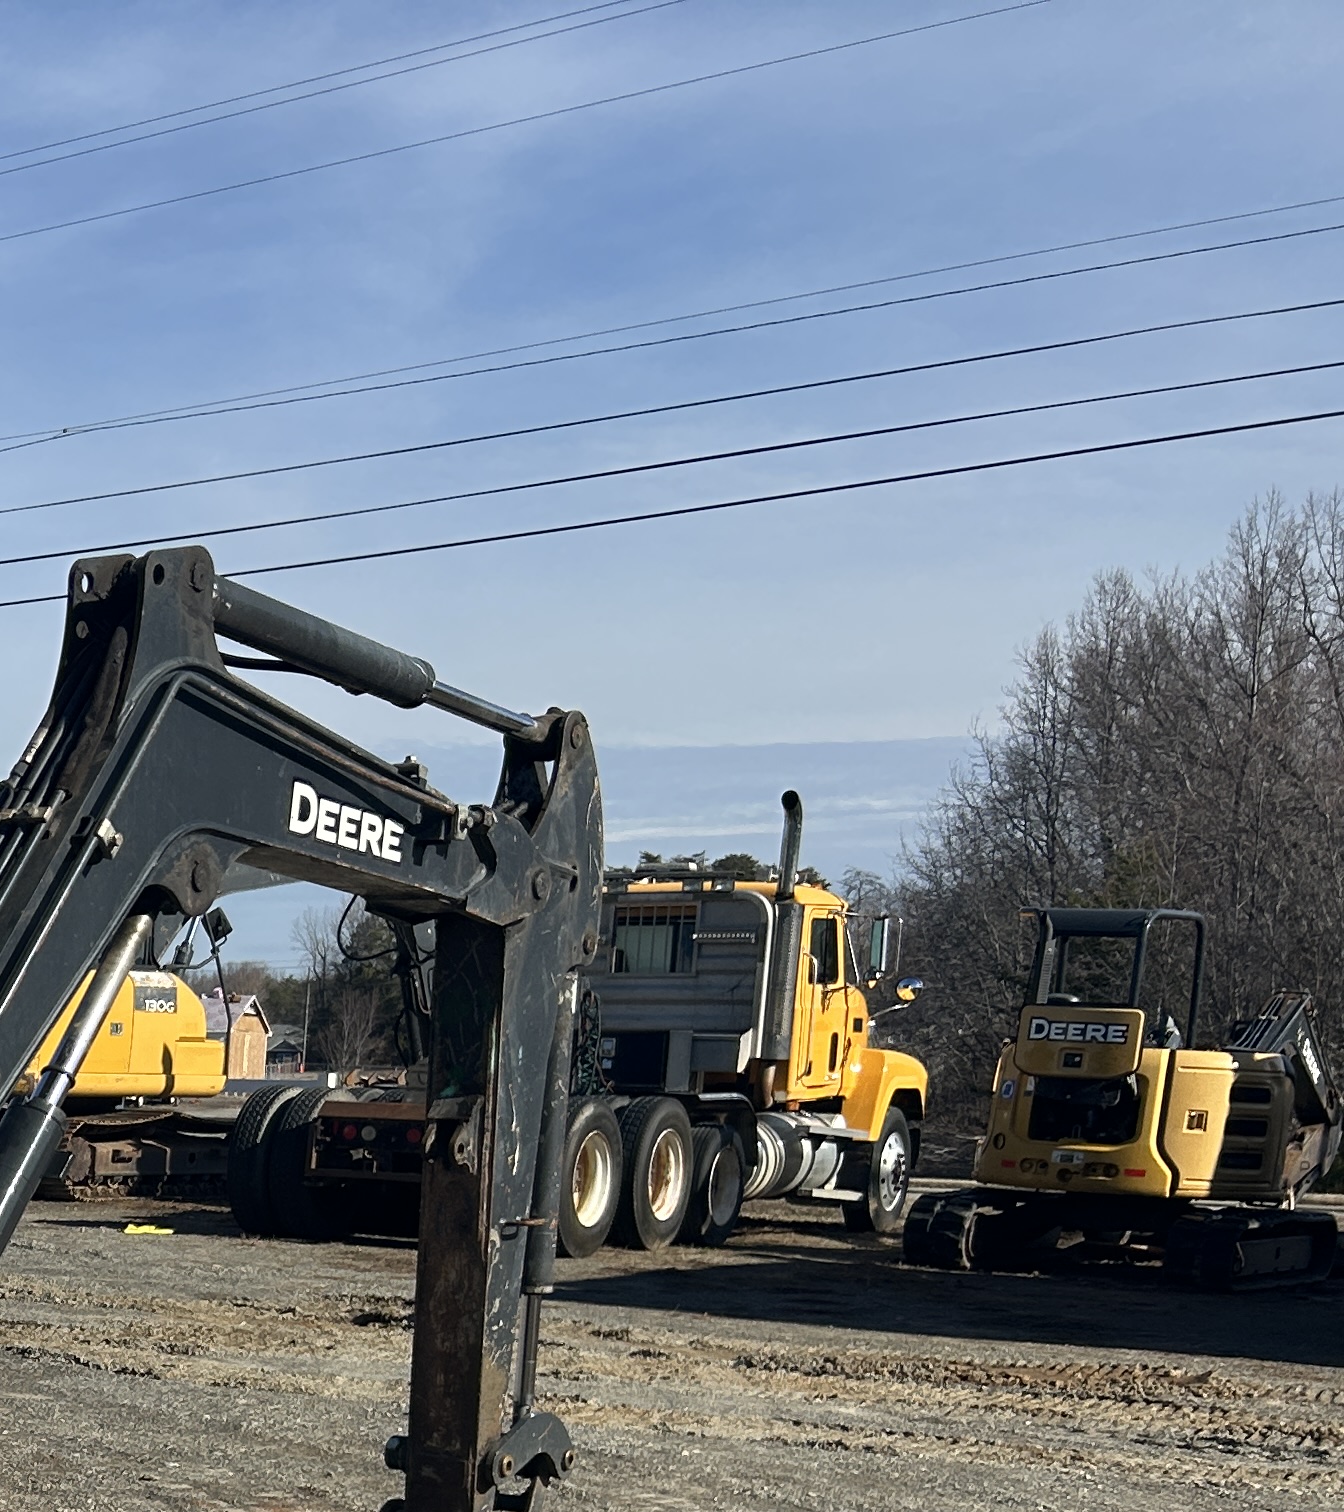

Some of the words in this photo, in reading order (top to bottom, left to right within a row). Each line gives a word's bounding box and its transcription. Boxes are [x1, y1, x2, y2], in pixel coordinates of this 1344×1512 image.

[289, 780, 405, 863] DEERE
[145, 1000, 175, 1014] 130G
[1029, 1018, 1127, 1043] DEERE
